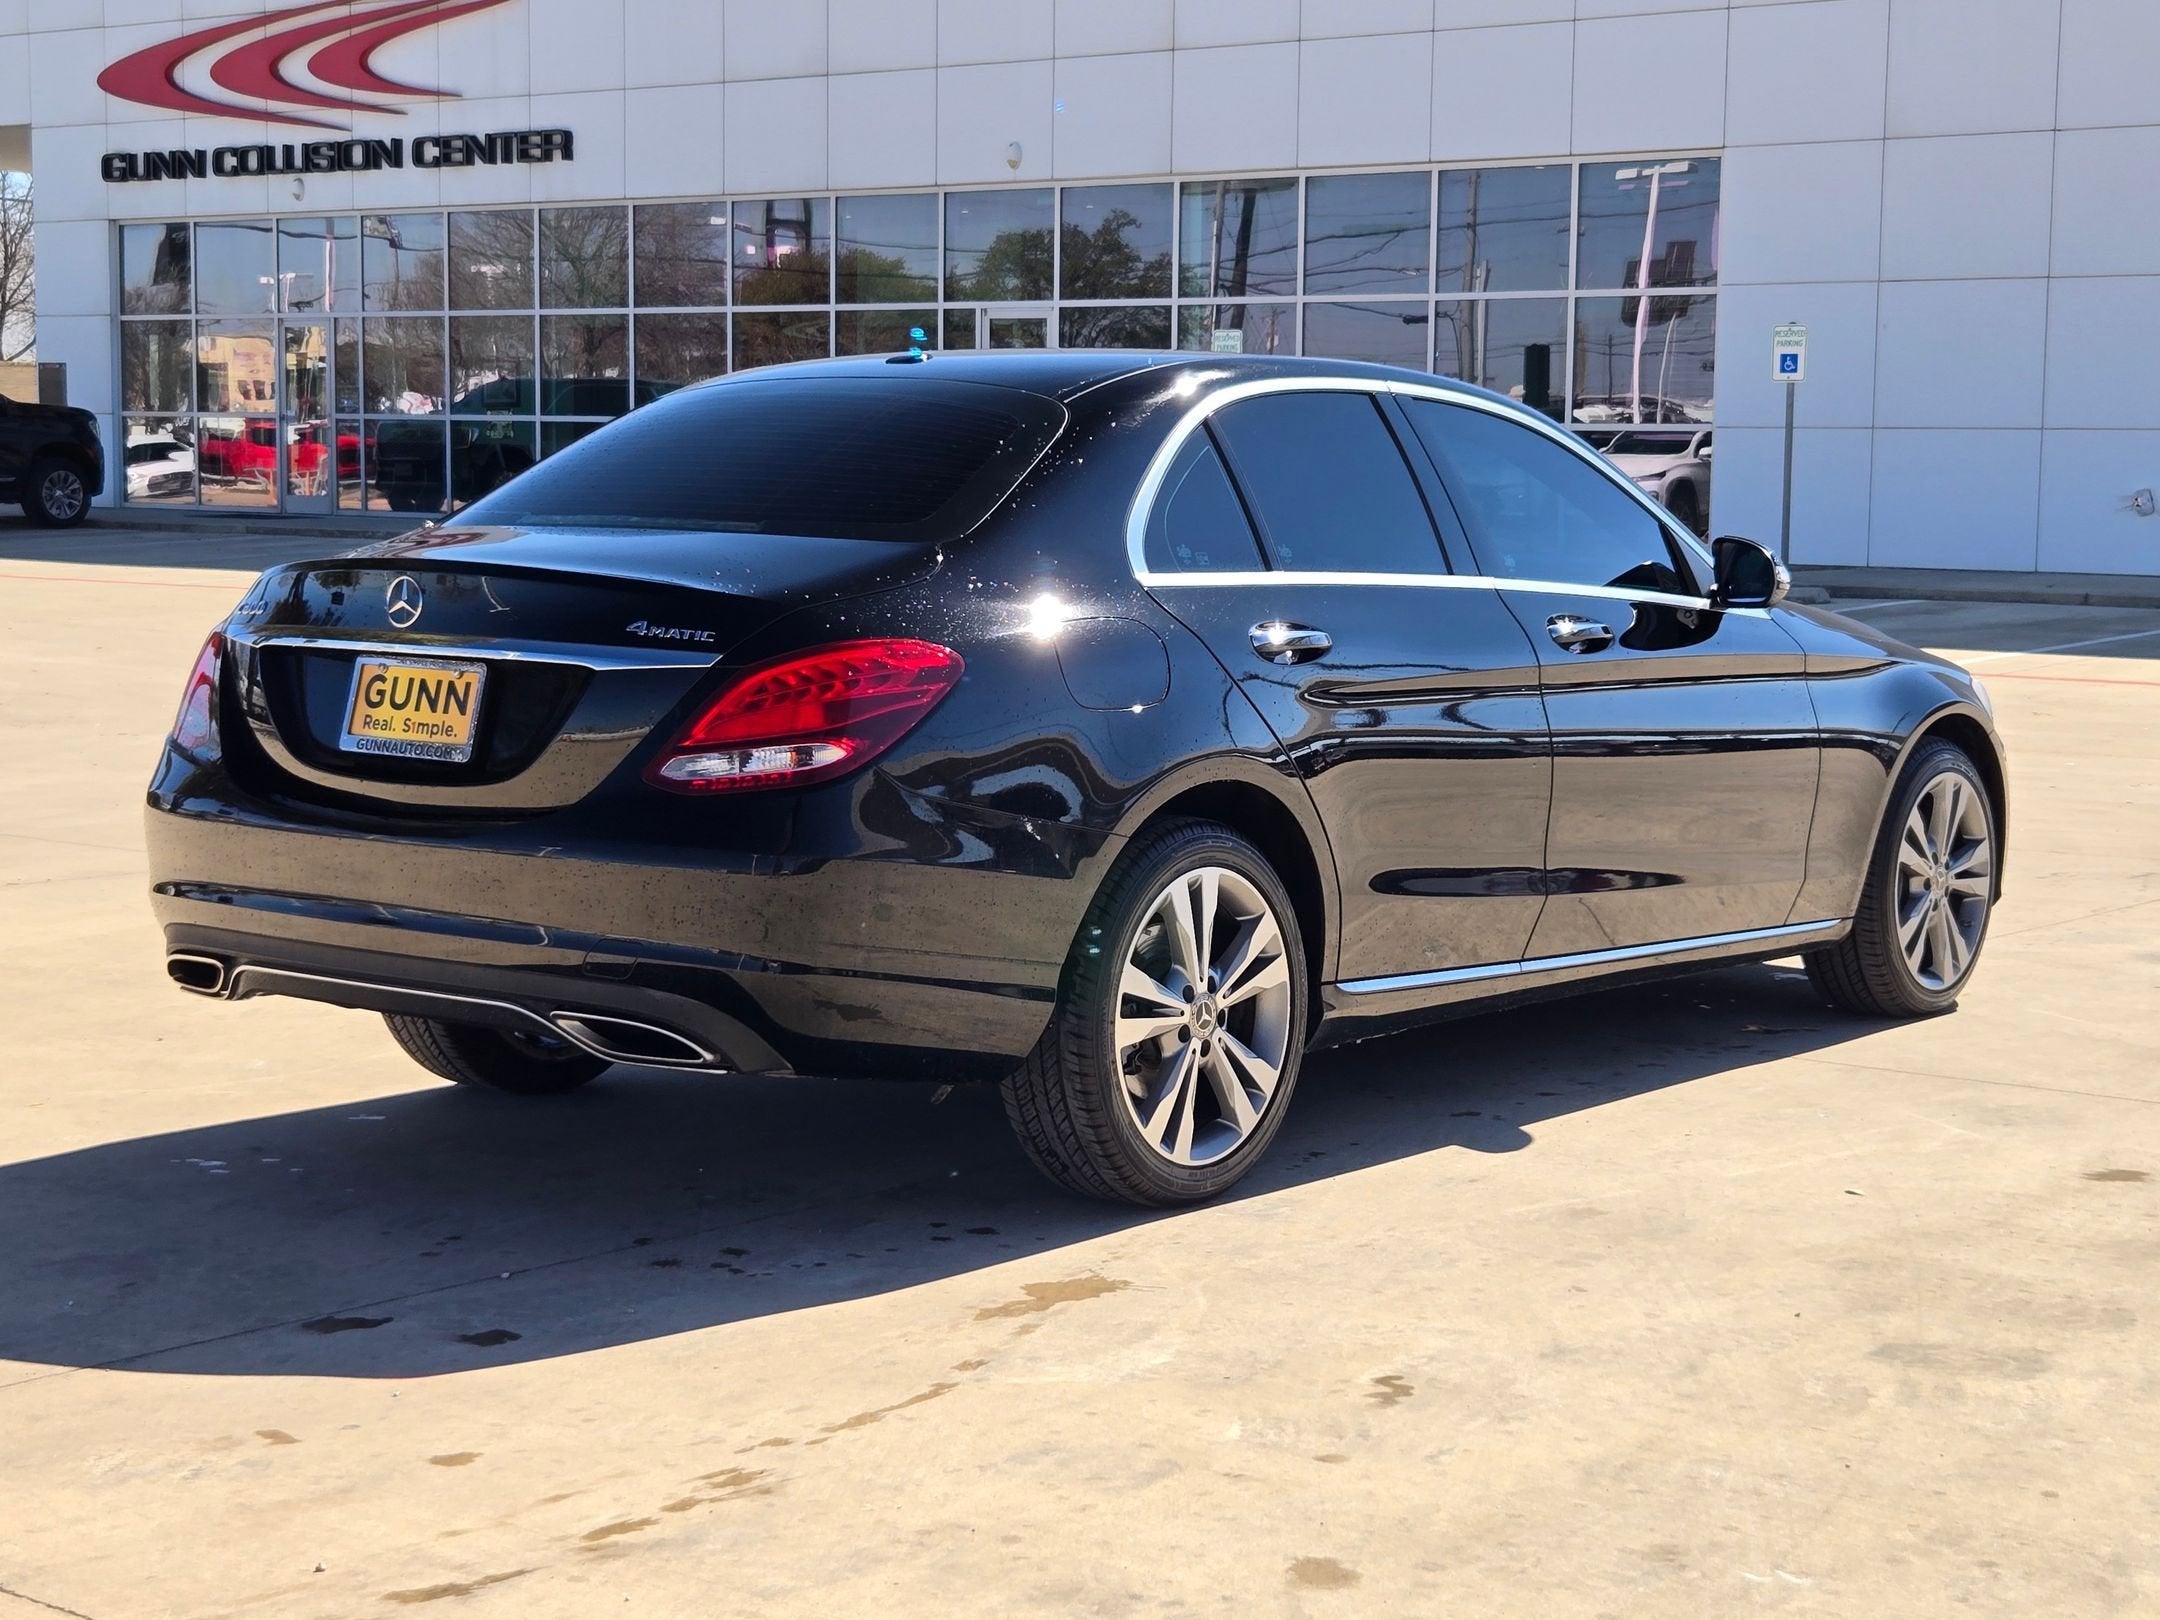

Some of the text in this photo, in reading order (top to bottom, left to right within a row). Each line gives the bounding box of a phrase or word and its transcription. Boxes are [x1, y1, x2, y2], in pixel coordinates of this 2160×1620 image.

[100, 129, 574, 182] GUNN COLLISION CENTER
[625, 620, 716, 642] 4MATIC
[364, 673, 472, 716] GUNN
[362, 714, 397, 732] Real.
